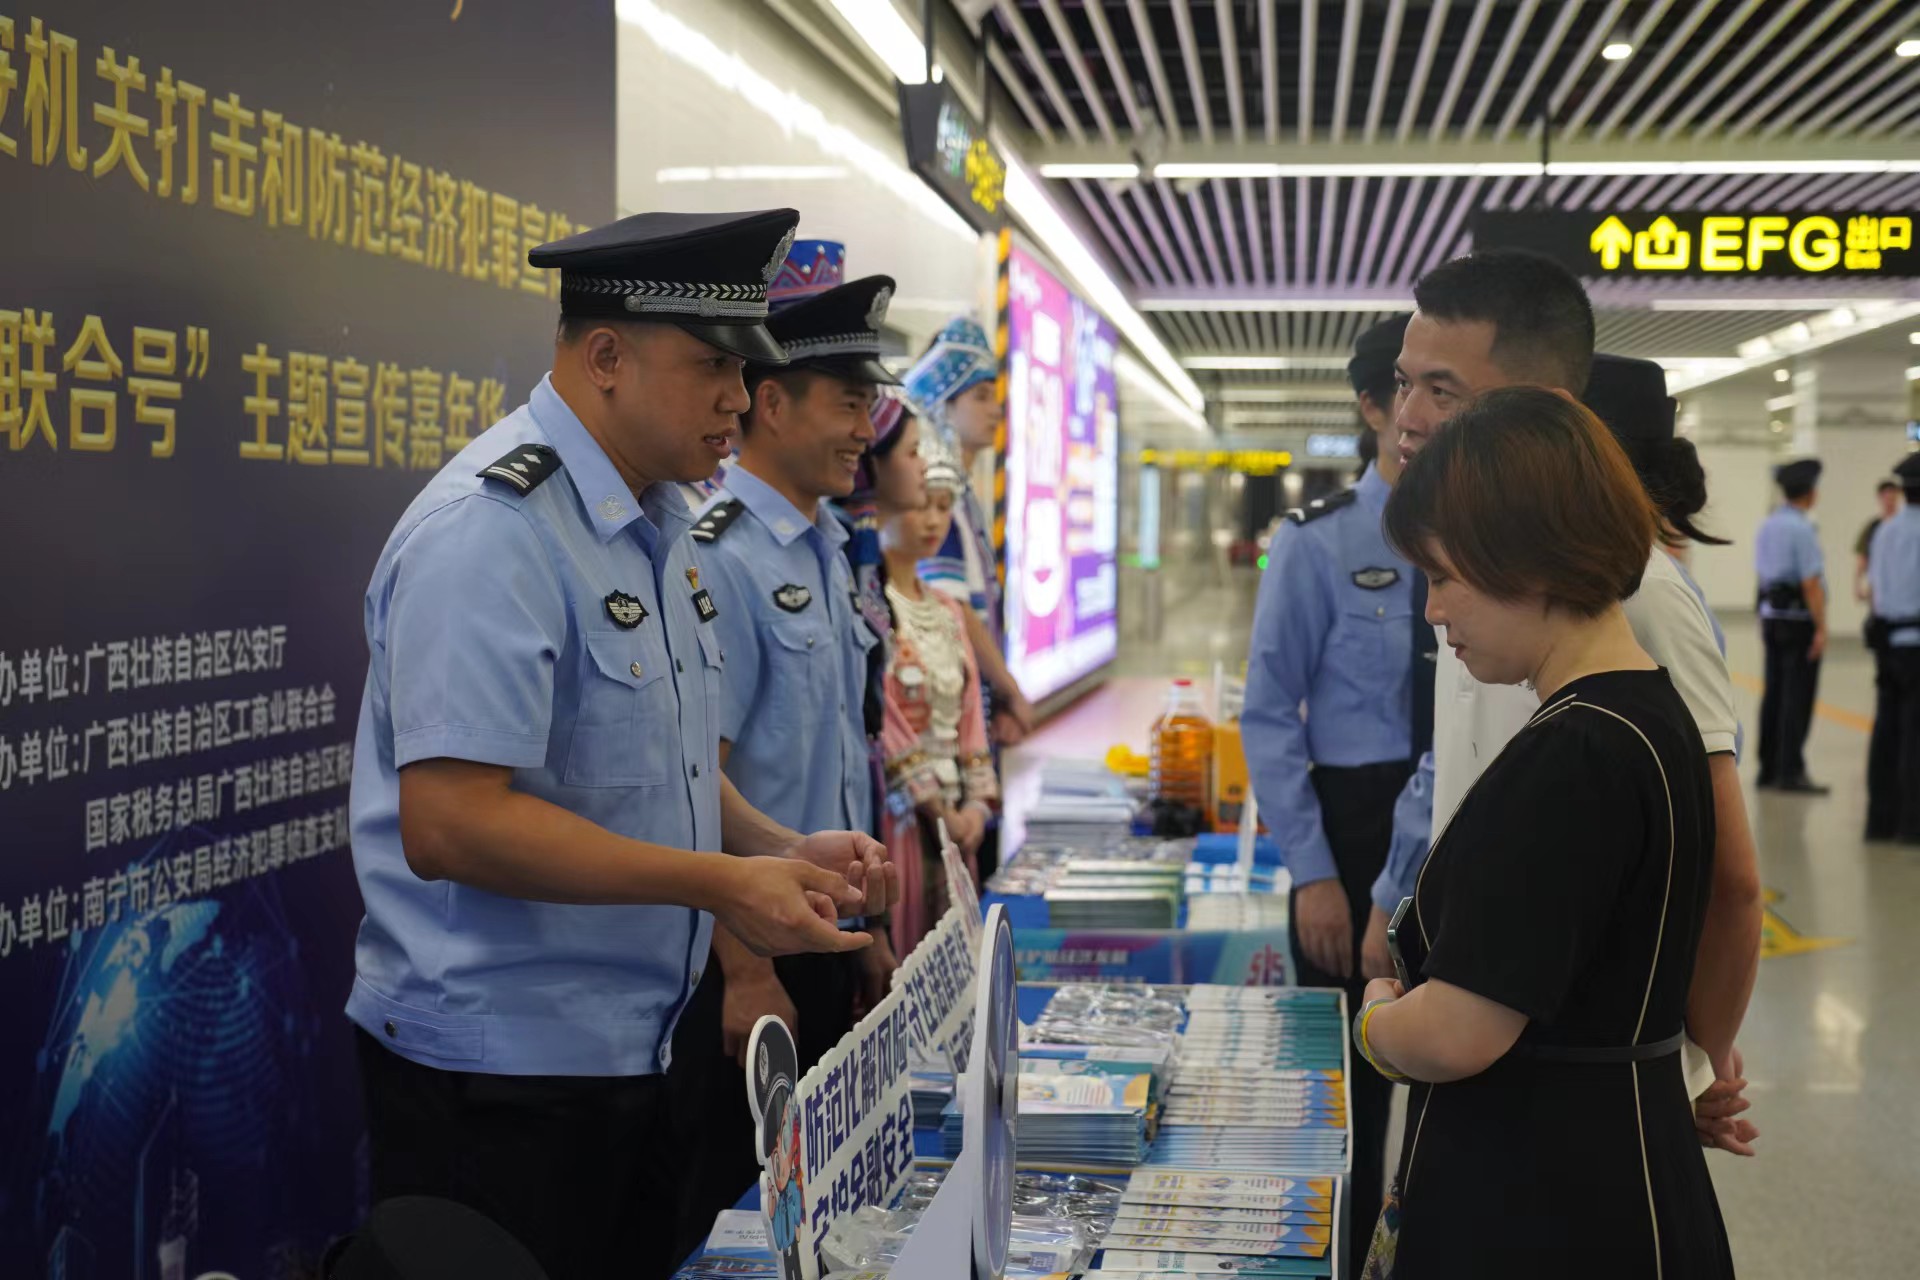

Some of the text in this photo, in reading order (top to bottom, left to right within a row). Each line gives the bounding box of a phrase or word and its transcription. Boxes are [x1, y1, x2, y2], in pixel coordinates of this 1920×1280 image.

[1701, 215, 1840, 271] EFG
[805, 1000, 908, 1185] 防范化解风险
